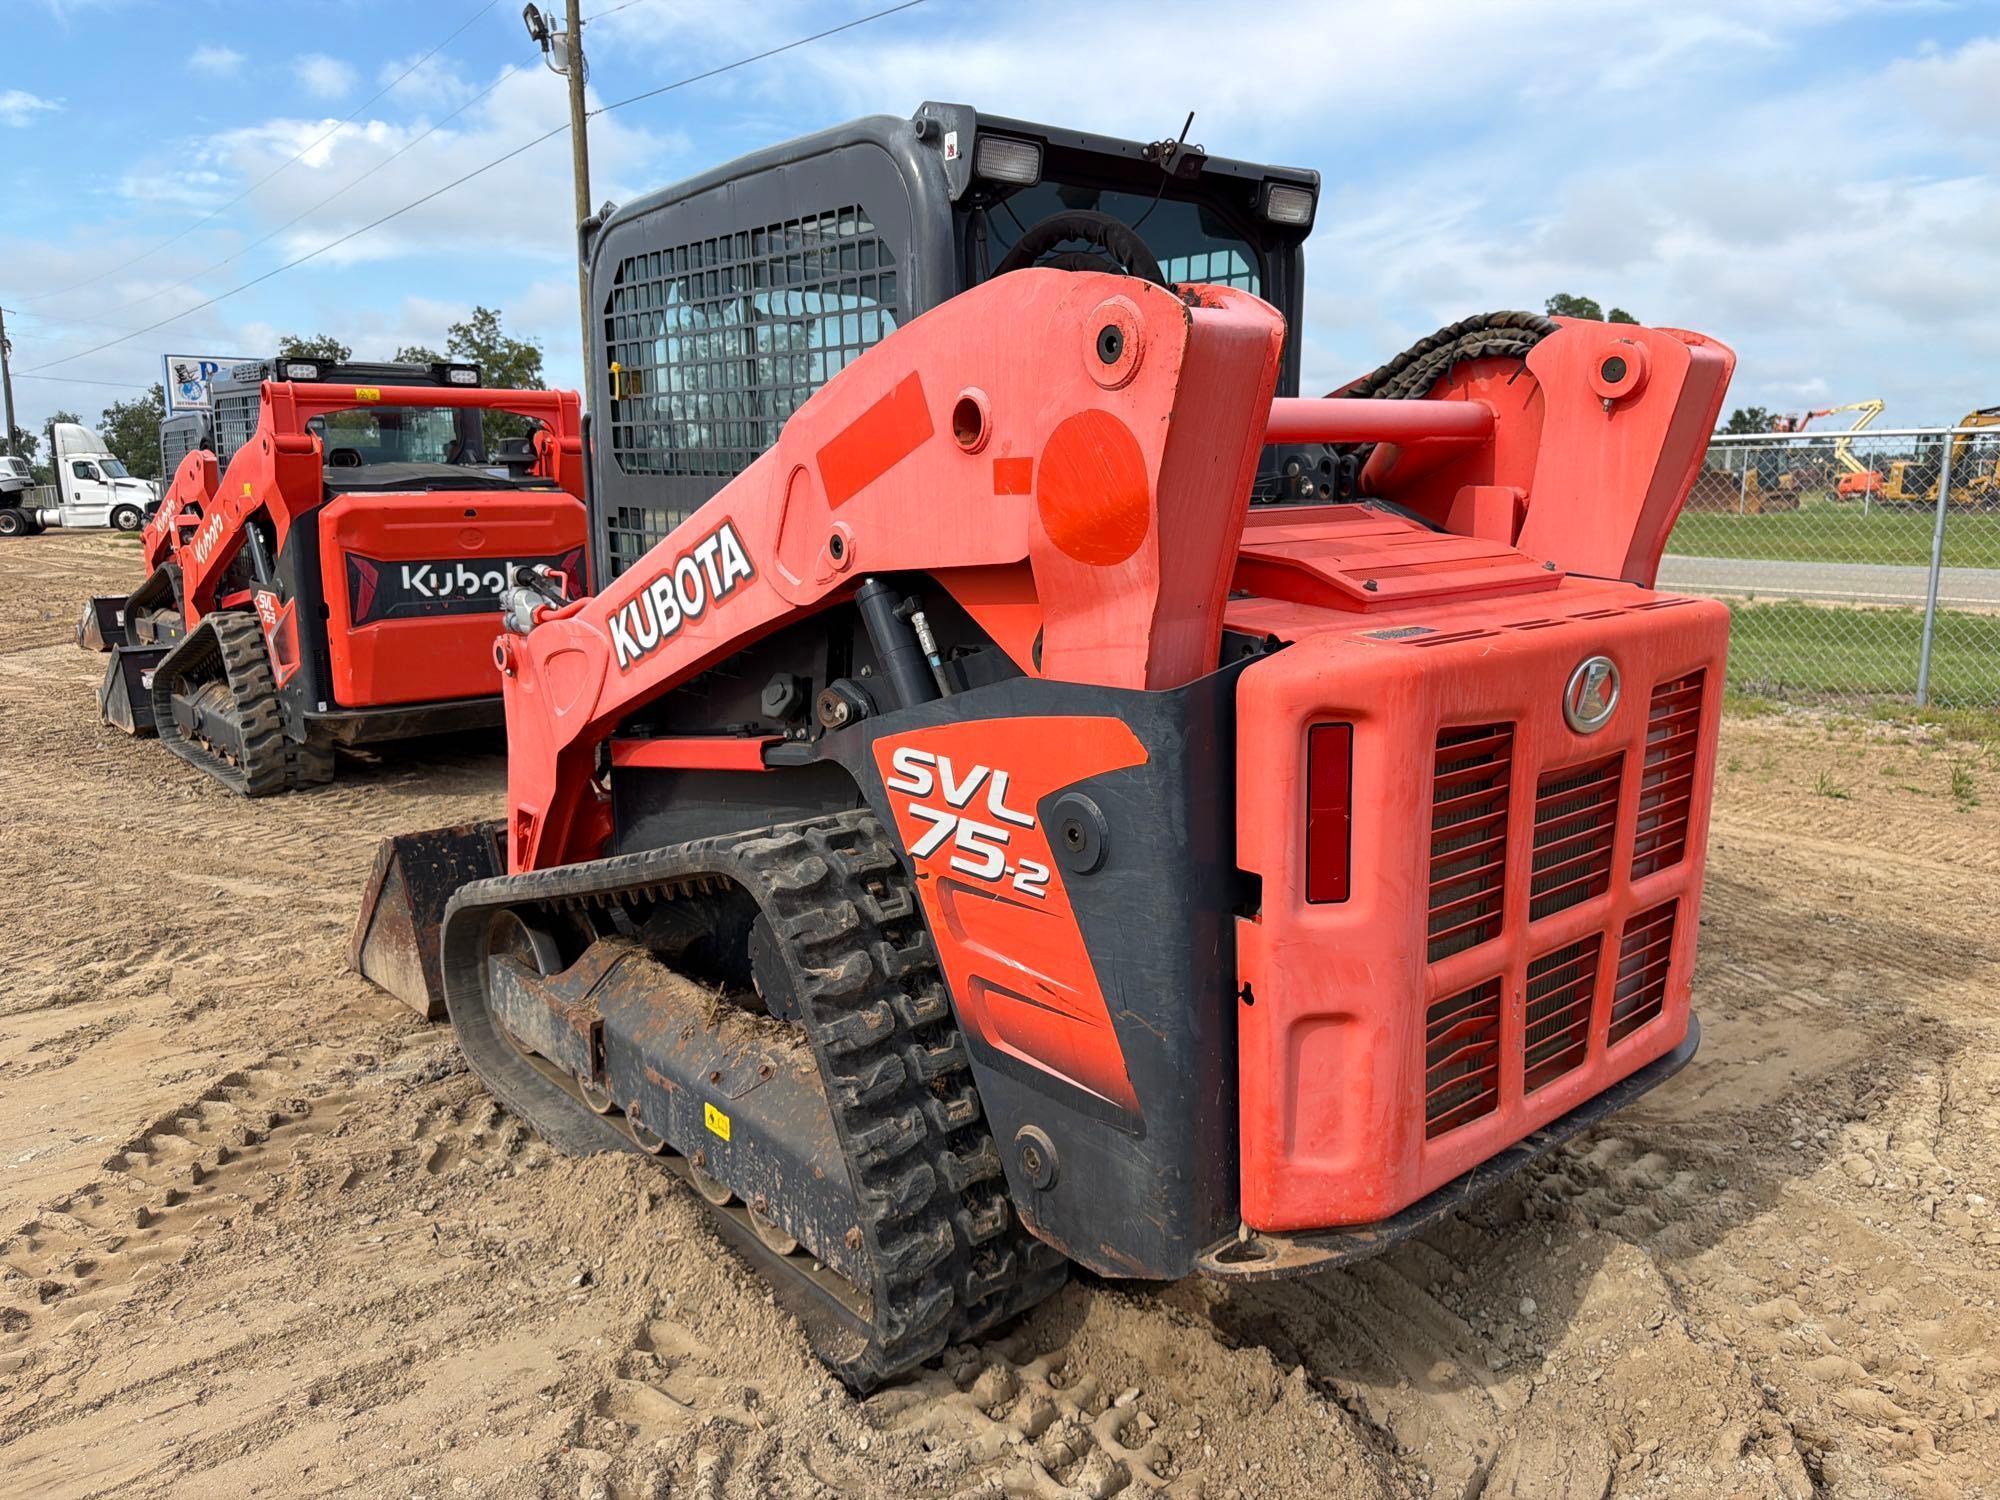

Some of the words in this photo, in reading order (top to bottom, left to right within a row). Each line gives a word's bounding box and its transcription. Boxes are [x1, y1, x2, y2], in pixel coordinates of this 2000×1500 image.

[194, 513, 223, 564] Kubota
[259, 594, 275, 611] SVL
[608, 523, 752, 668] KUBOTA
[887, 746, 1036, 830] SVL
[908, 803, 1051, 899] 75-2
